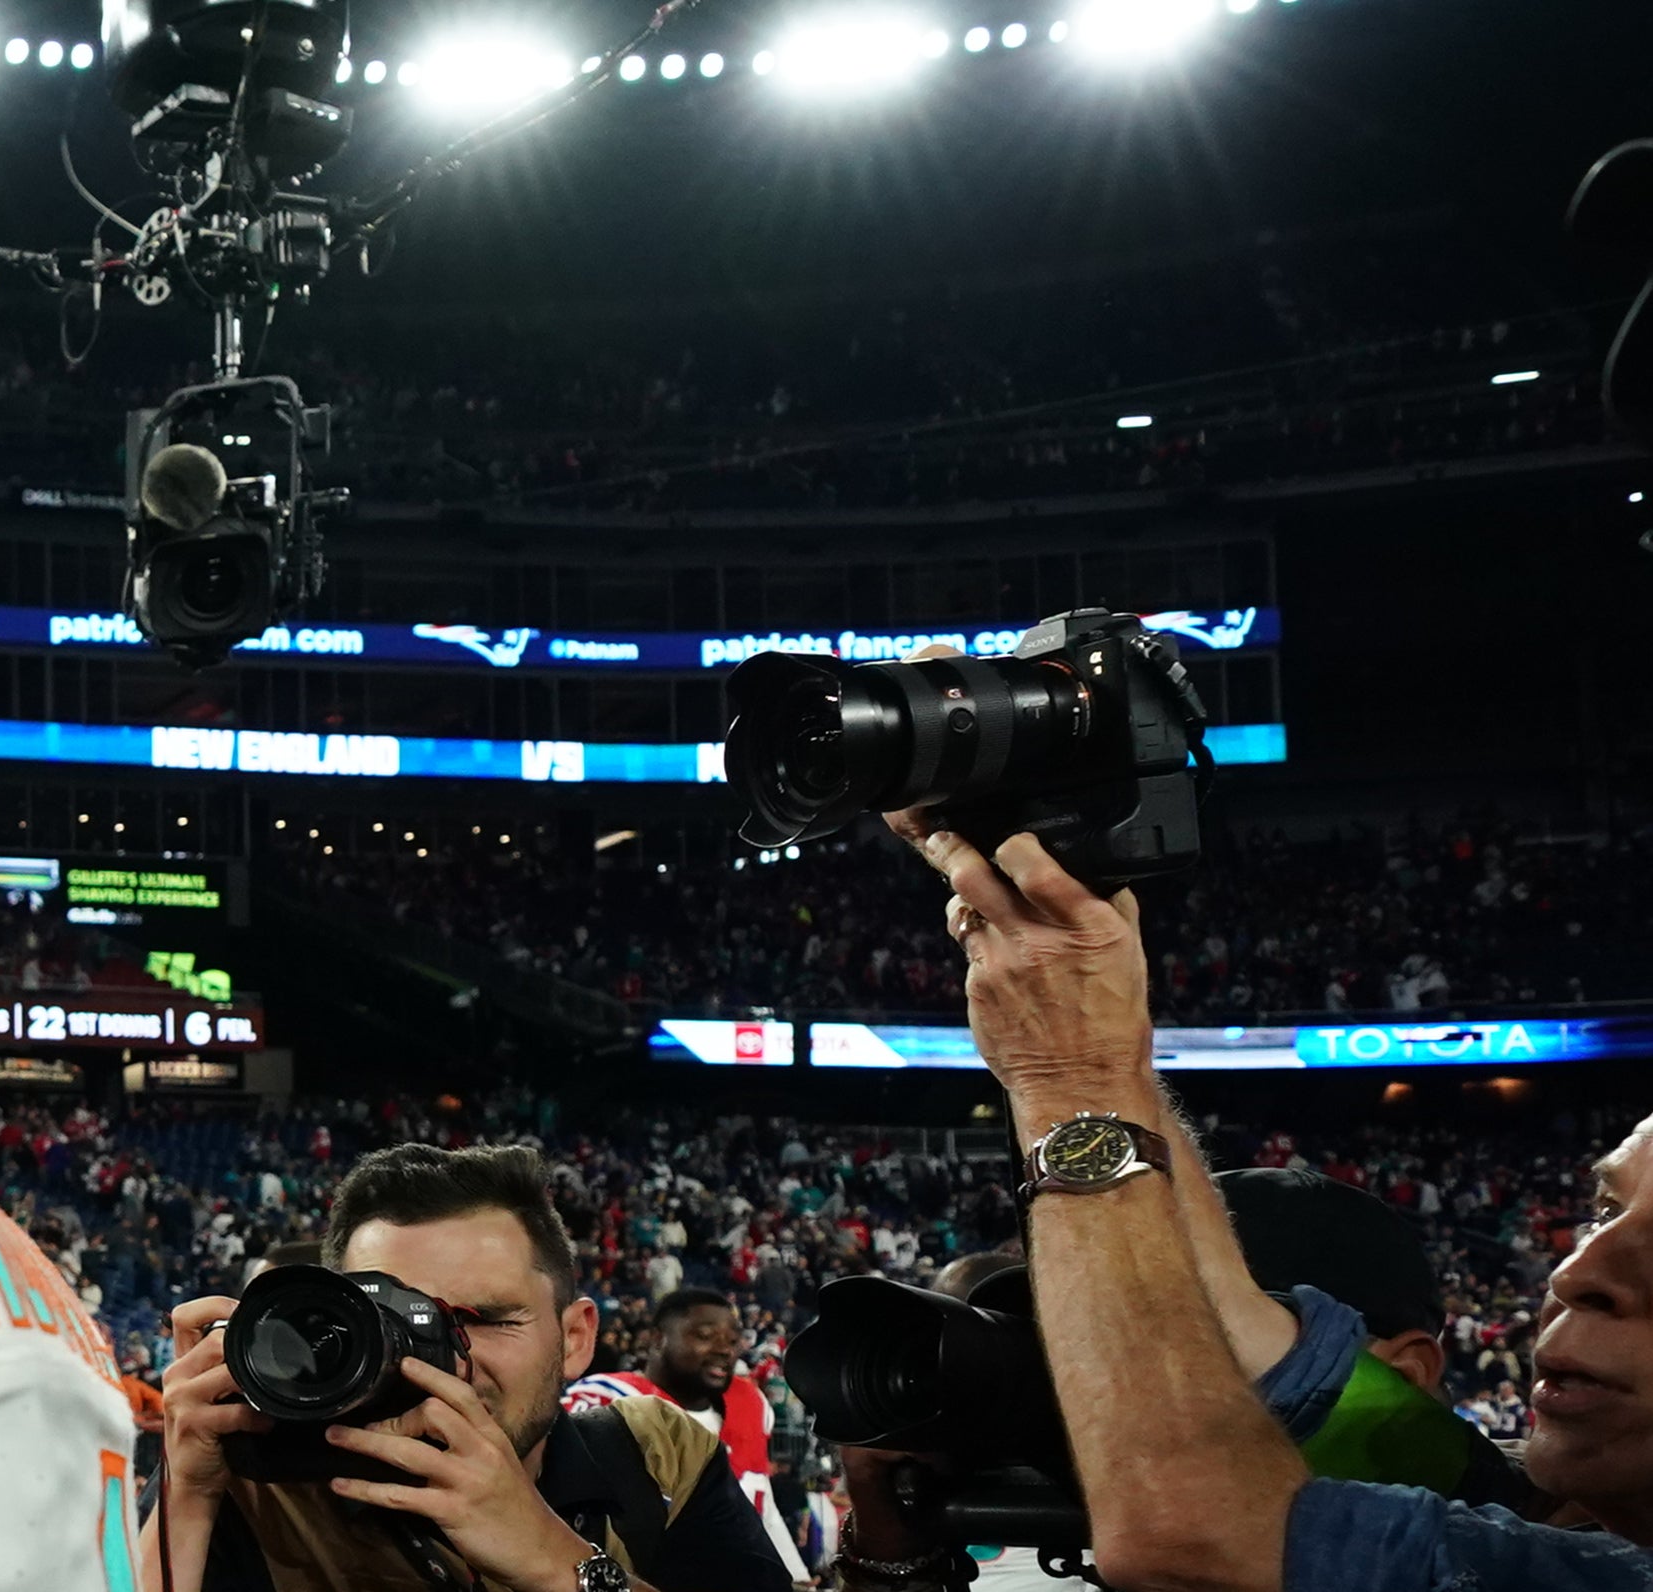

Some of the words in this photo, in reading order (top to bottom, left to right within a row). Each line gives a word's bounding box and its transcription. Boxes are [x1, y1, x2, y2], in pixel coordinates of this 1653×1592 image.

[152, 726, 235, 770] NEW
[238, 730, 400, 776] ENGLAND
[522, 740, 584, 781] VS
[27, 1004, 66, 1042] 22
[184, 1010, 212, 1046] 6
